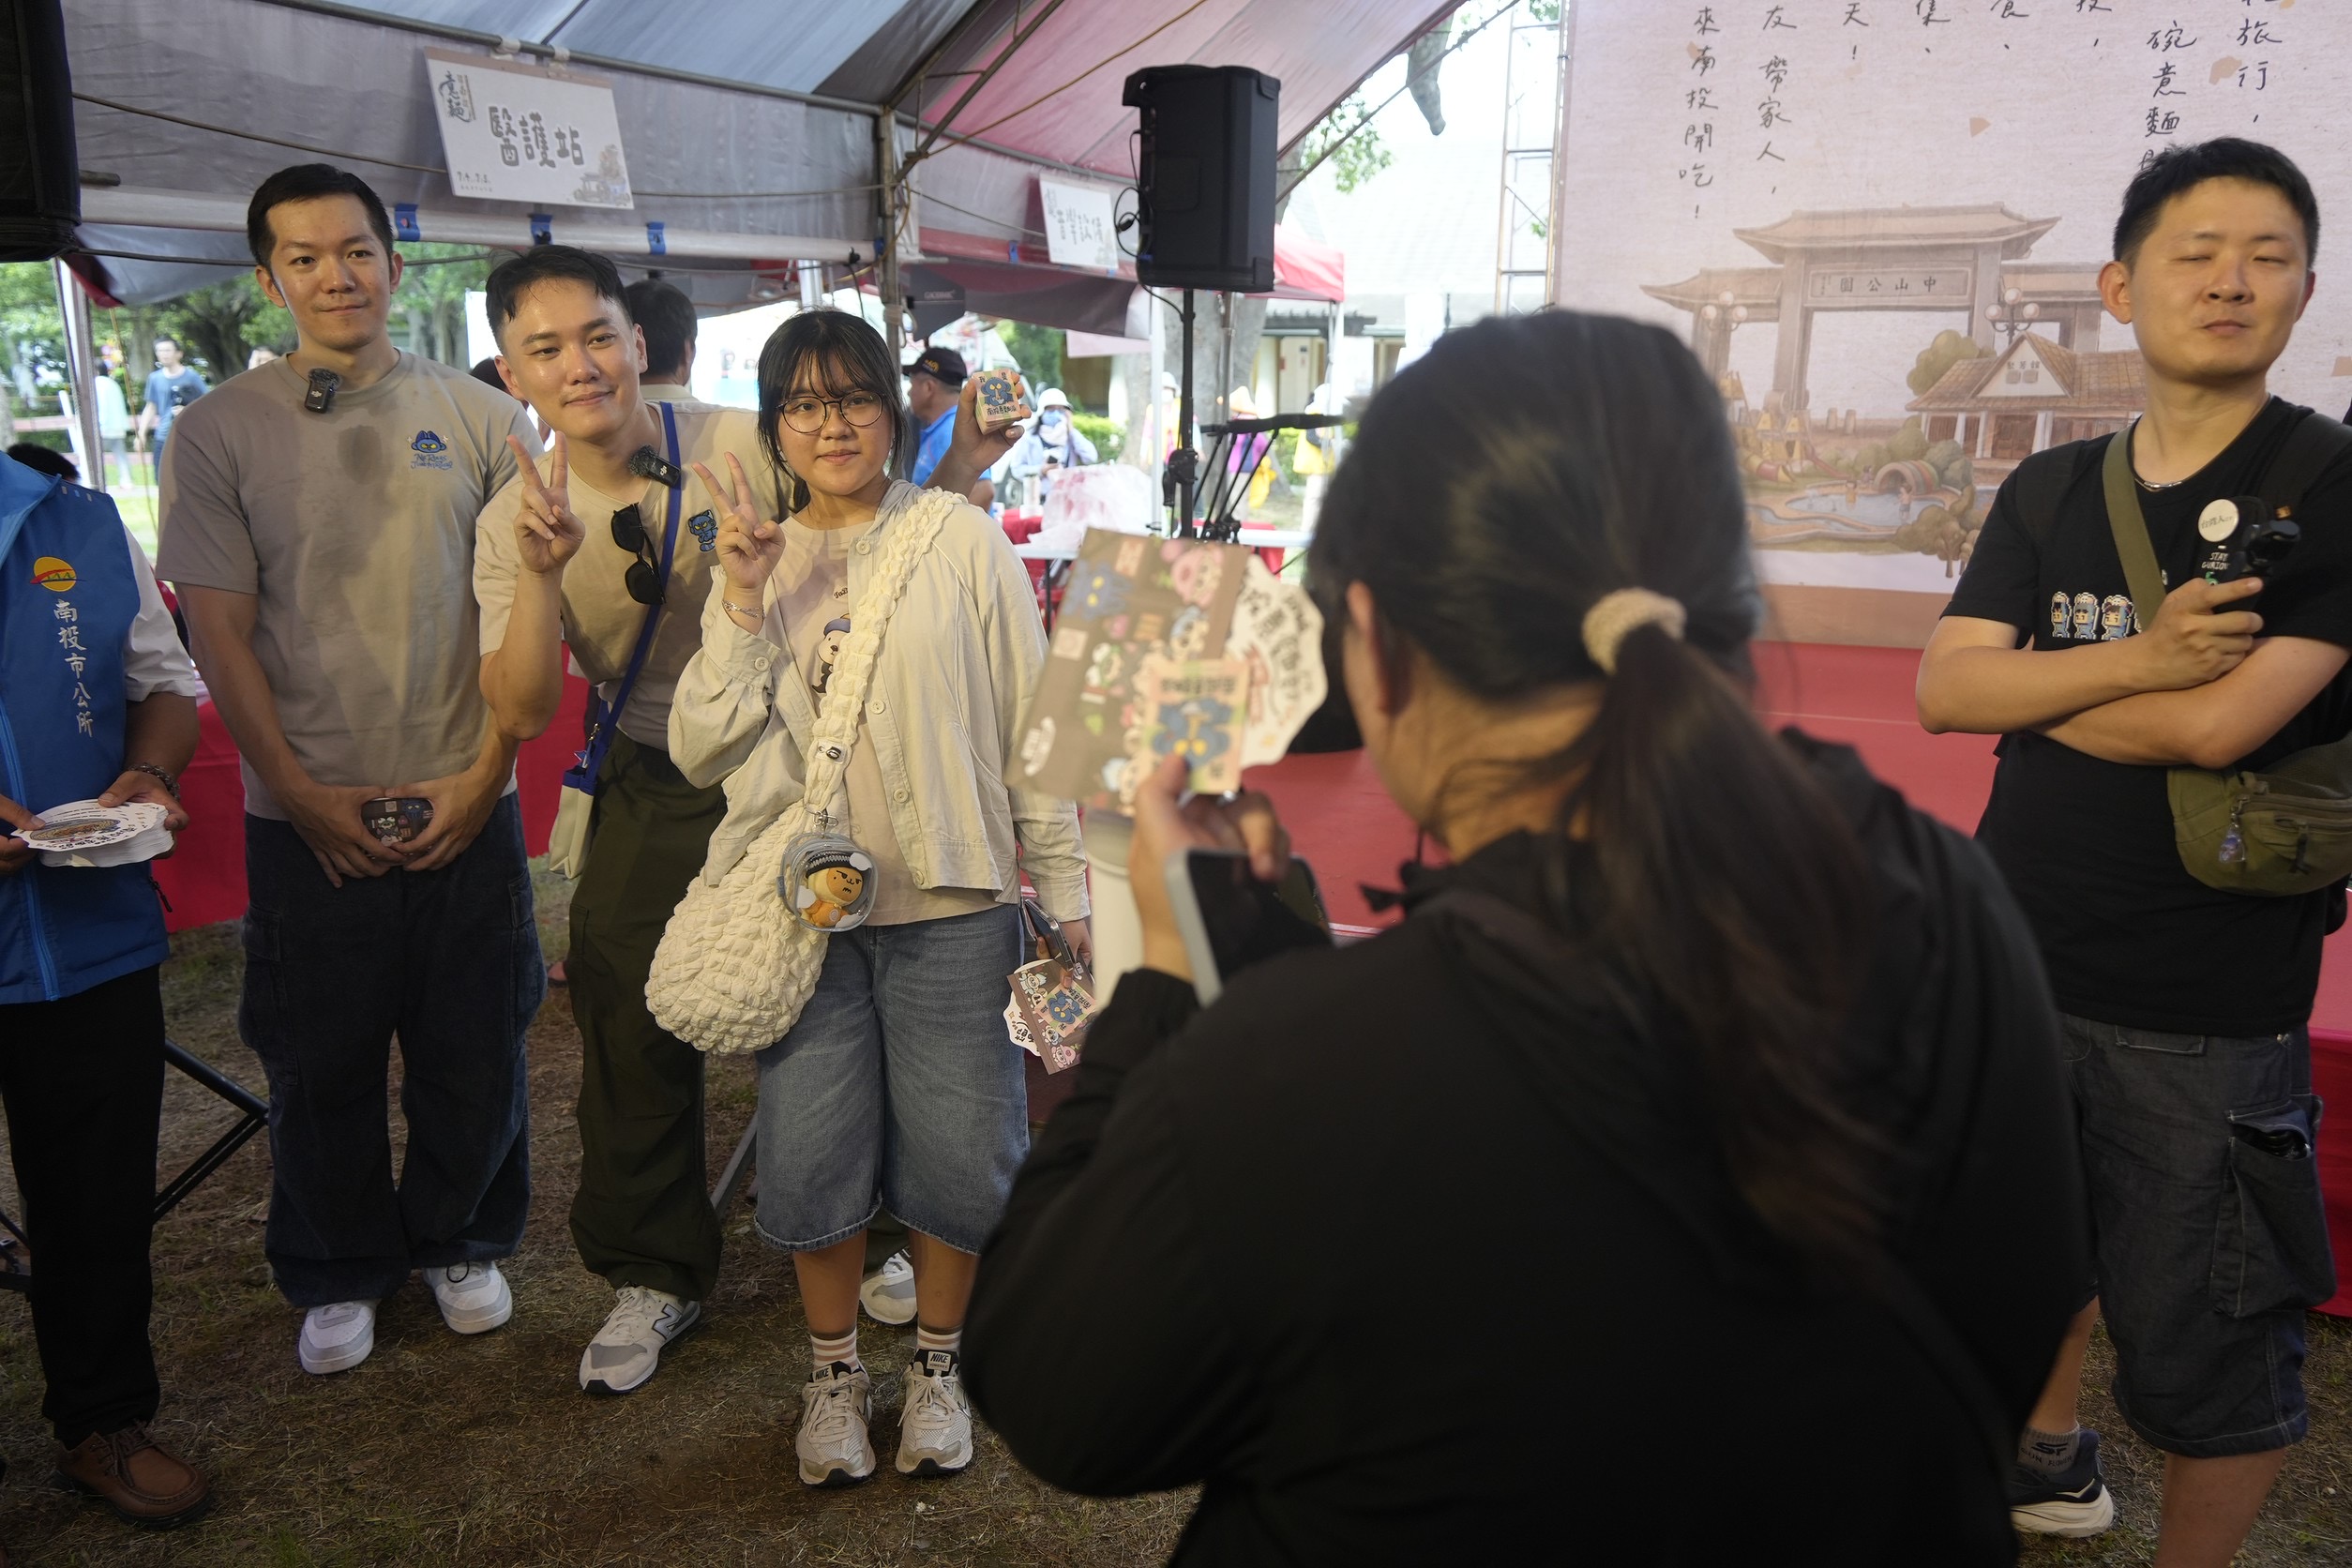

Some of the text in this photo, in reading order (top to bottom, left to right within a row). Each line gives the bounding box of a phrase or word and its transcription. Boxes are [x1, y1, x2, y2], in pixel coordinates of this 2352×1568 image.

[2236, 0, 2283, 123] 旅行，
[488, 106, 584, 169] 醫護站
[1840, 276, 1937, 293] 中山公園
[53, 598, 94, 738] 南投市公所
[815, 1367, 829, 1380] NIKE
[930, 1352, 949, 1364] NIKE
